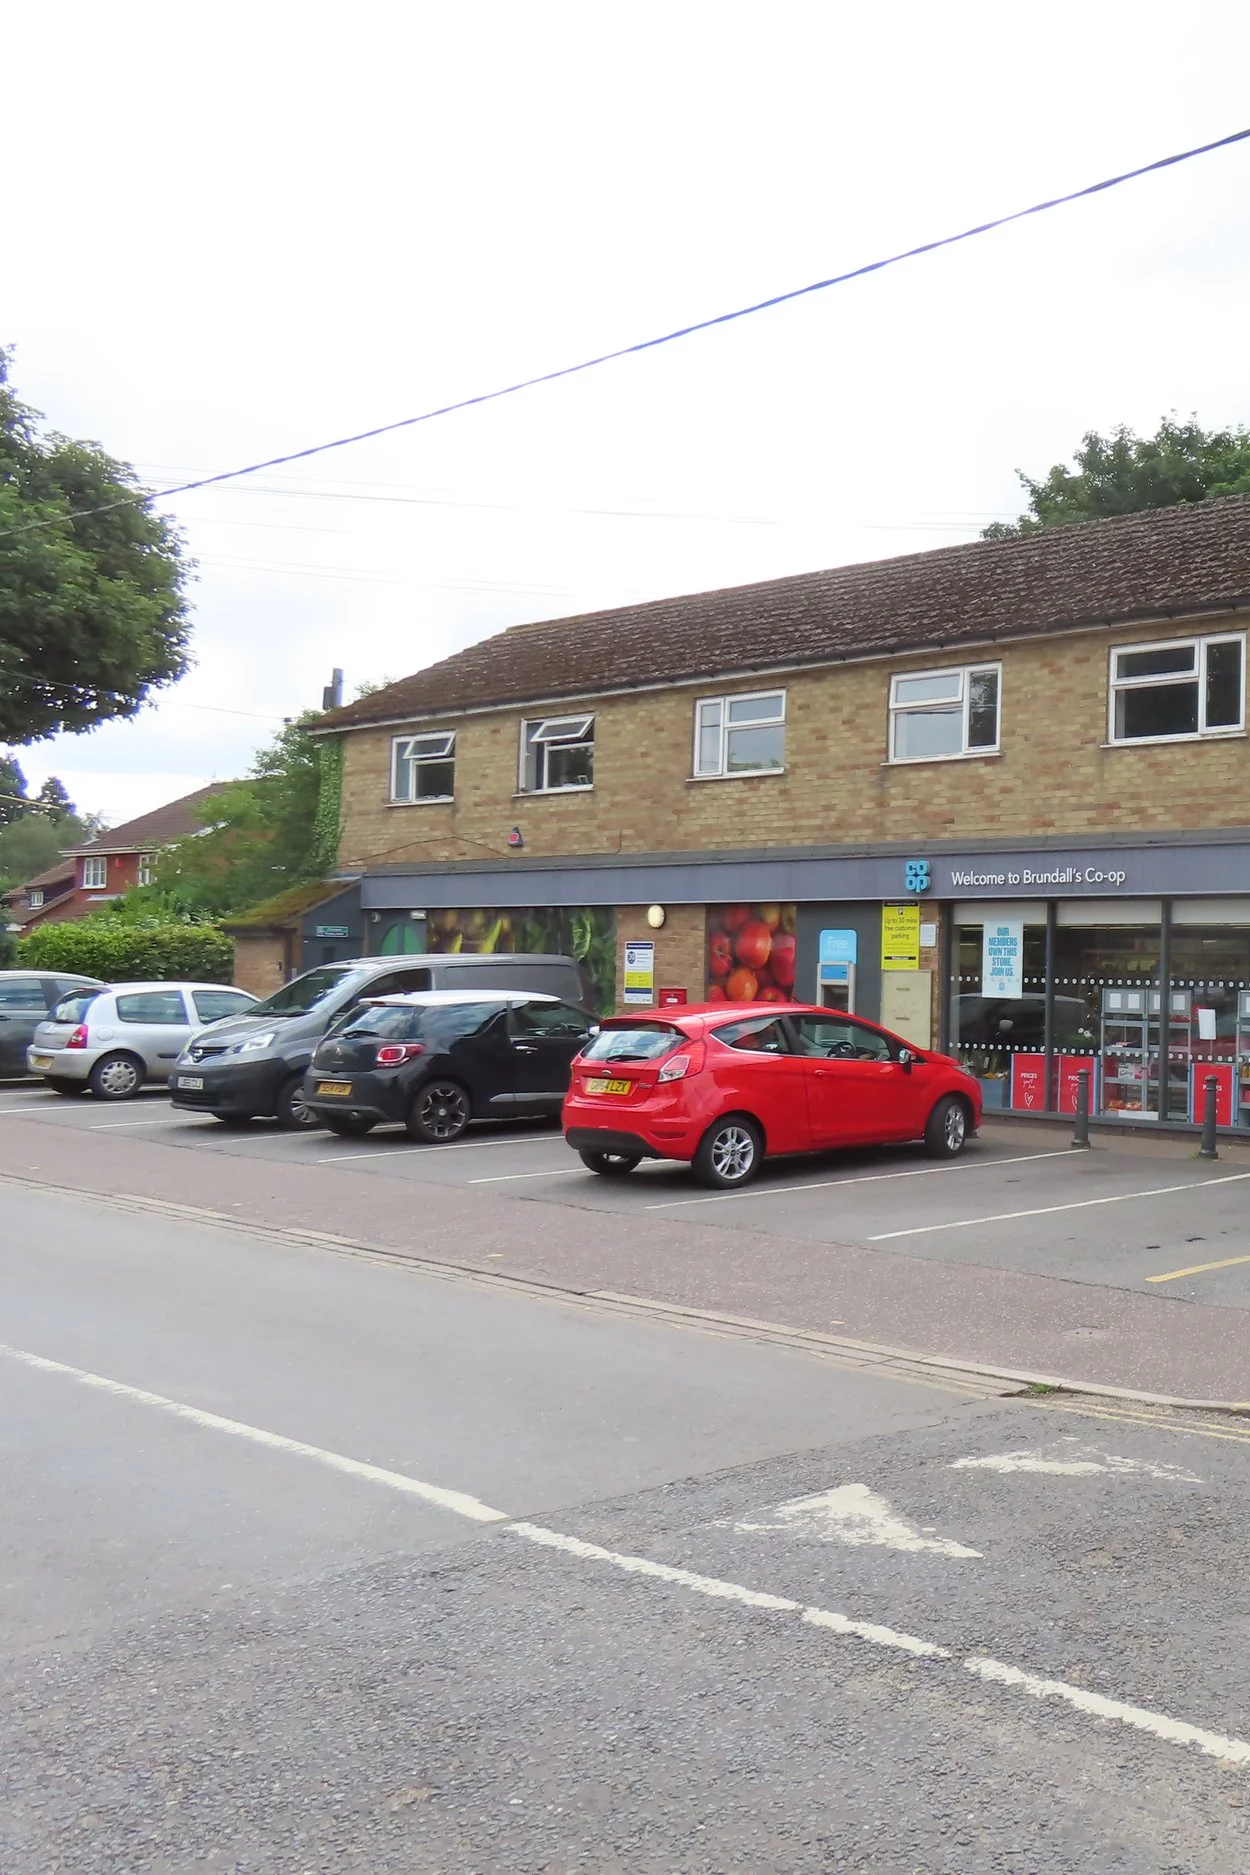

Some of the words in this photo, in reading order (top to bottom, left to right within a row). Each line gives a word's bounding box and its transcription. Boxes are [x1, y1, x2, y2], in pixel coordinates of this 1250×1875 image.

[951, 871, 1005, 886] Welcome
[1008, 872, 1020, 885] to
[1023, 868, 1082, 884] Brundall's
[1085, 867, 1126, 886] Co-op
[997, 927, 1009, 936] OUR
[988, 937, 1018, 946] MEMBERS
[988, 947, 1002, 956] OWN
[1003, 947, 1018, 956] THIS
[992, 957, 1013, 966] STORE.
[990, 967, 1004, 976] JOIN
[610, 1081, 628, 1093] LZX
